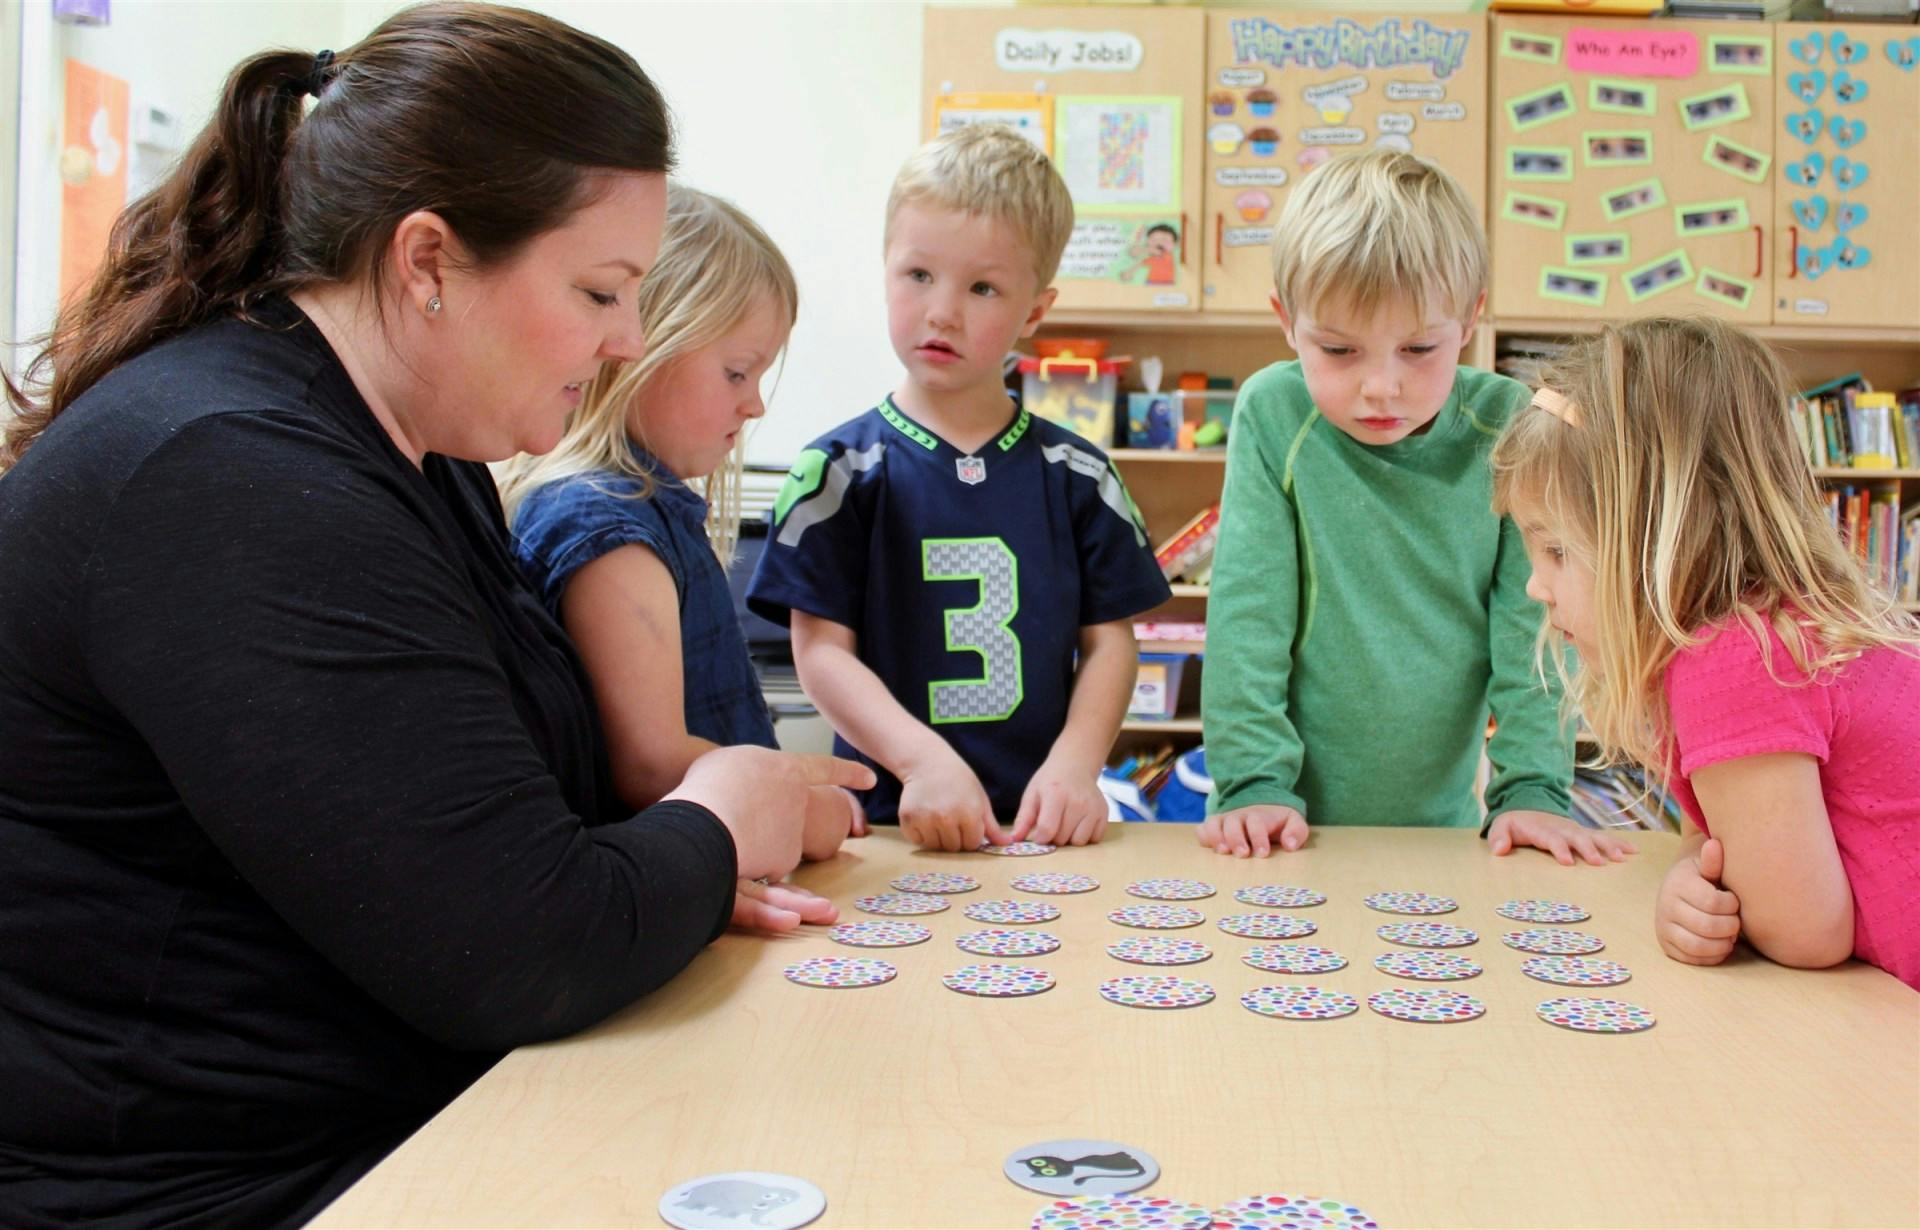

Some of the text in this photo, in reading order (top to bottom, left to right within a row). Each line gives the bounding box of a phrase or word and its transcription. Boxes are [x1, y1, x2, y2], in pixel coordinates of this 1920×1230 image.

[1004, 41, 1133, 65] Daily Jobs!
[1231, 17, 1469, 78] Happy Birthday!
[1575, 42, 1688, 61] Who Am Eye?
[922, 537, 1024, 724] 3
